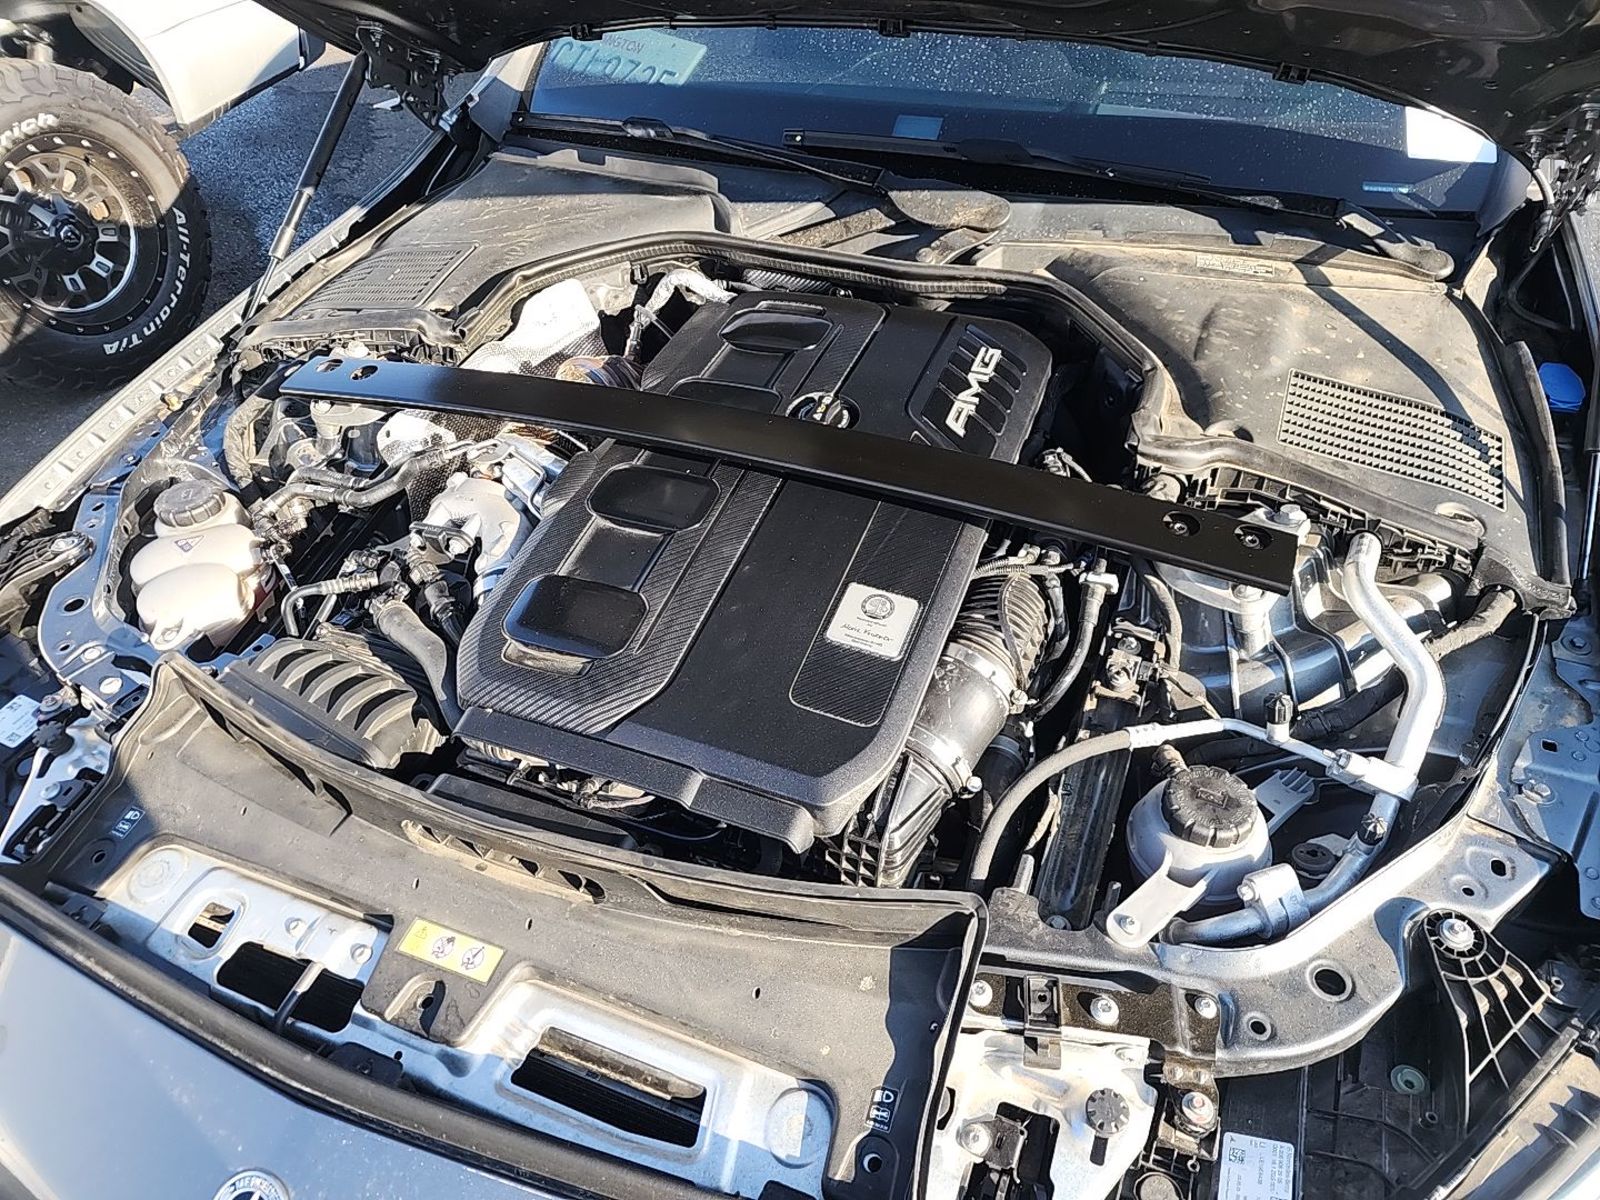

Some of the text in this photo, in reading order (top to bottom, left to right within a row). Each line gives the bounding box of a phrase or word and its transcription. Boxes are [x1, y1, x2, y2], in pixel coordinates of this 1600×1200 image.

[0, 112, 60, 150] rich
[103, 206, 191, 355] All-Terrain T/A
[945, 346, 1002, 438] AMG
